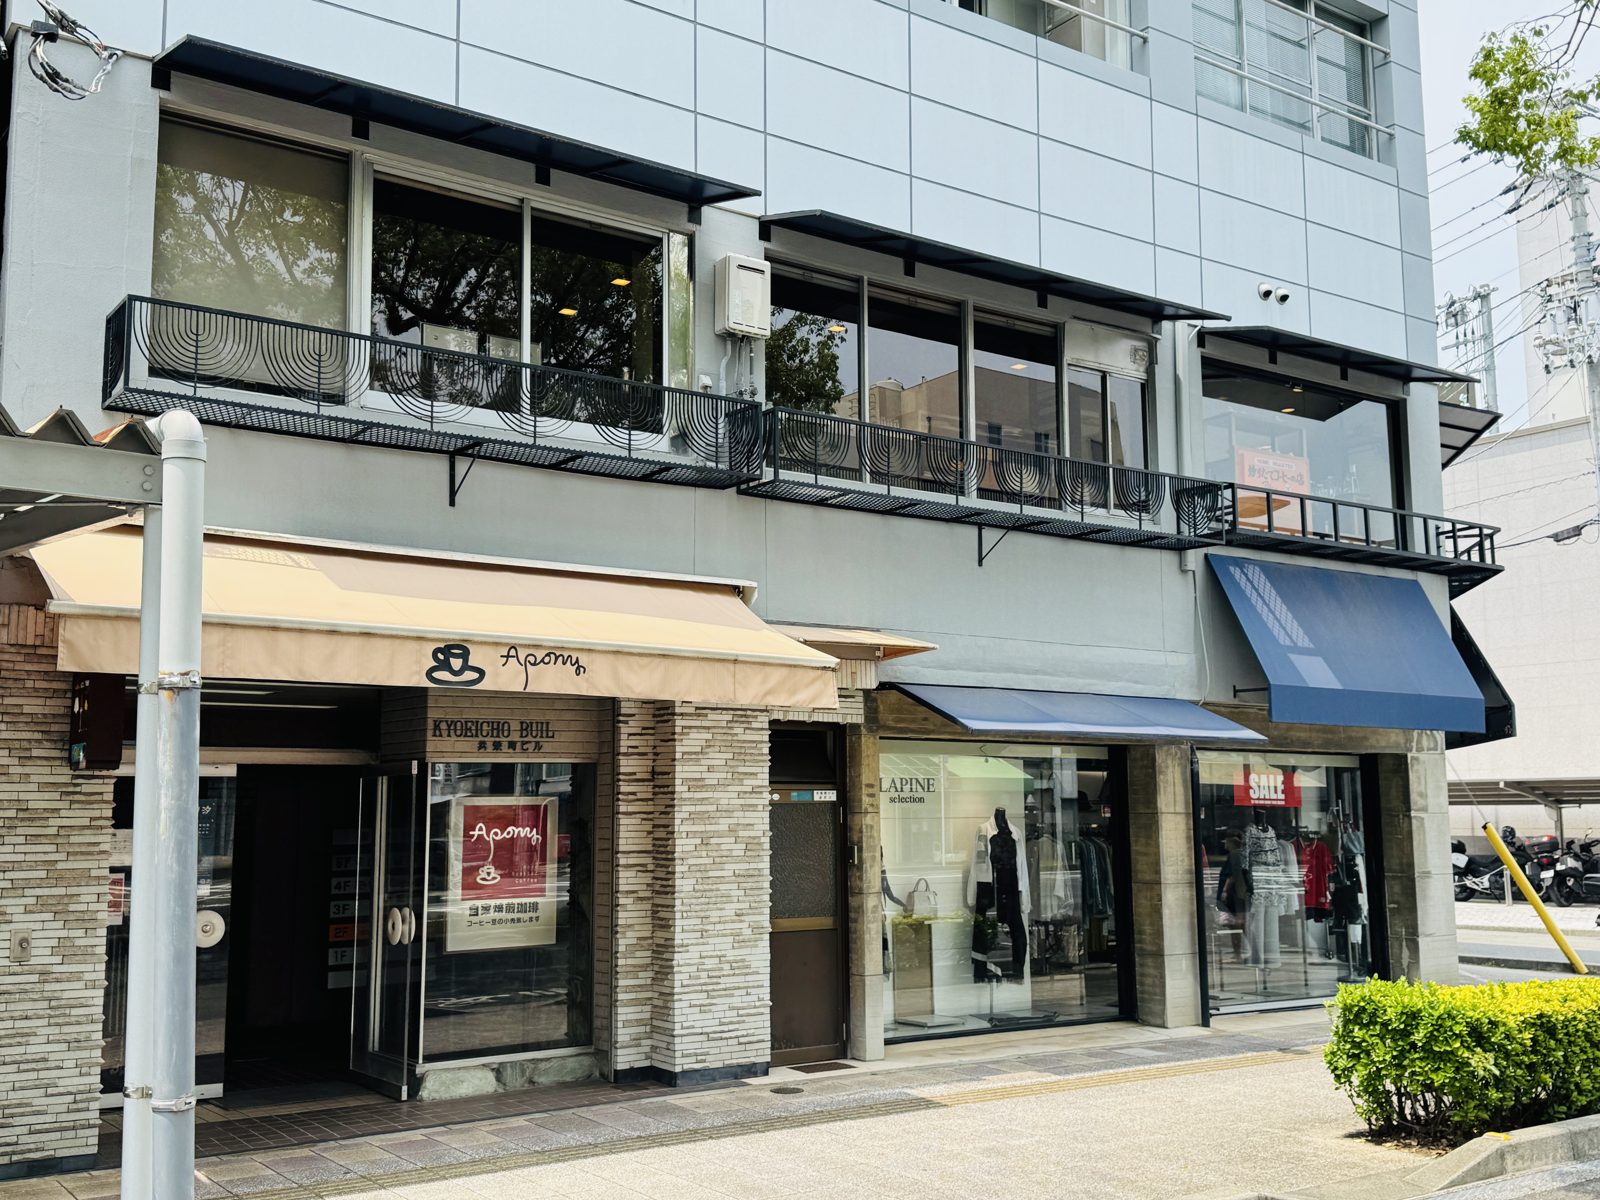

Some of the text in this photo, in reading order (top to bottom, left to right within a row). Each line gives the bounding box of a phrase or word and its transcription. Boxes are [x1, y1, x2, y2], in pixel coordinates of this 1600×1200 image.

[500, 645, 586, 691] Apony
[432, 719, 555, 739] KYOEICHO BUIL
[879, 777, 936, 793] LAPINE
[1249, 773, 1285, 799] SALE
[889, 794, 926, 804] selection
[469, 823, 542, 862] Apony
[334, 880, 351, 892] 4F
[333, 904, 350, 915] 3F
[335, 926, 350, 938] 2F
[334, 951, 348, 962] 1F
